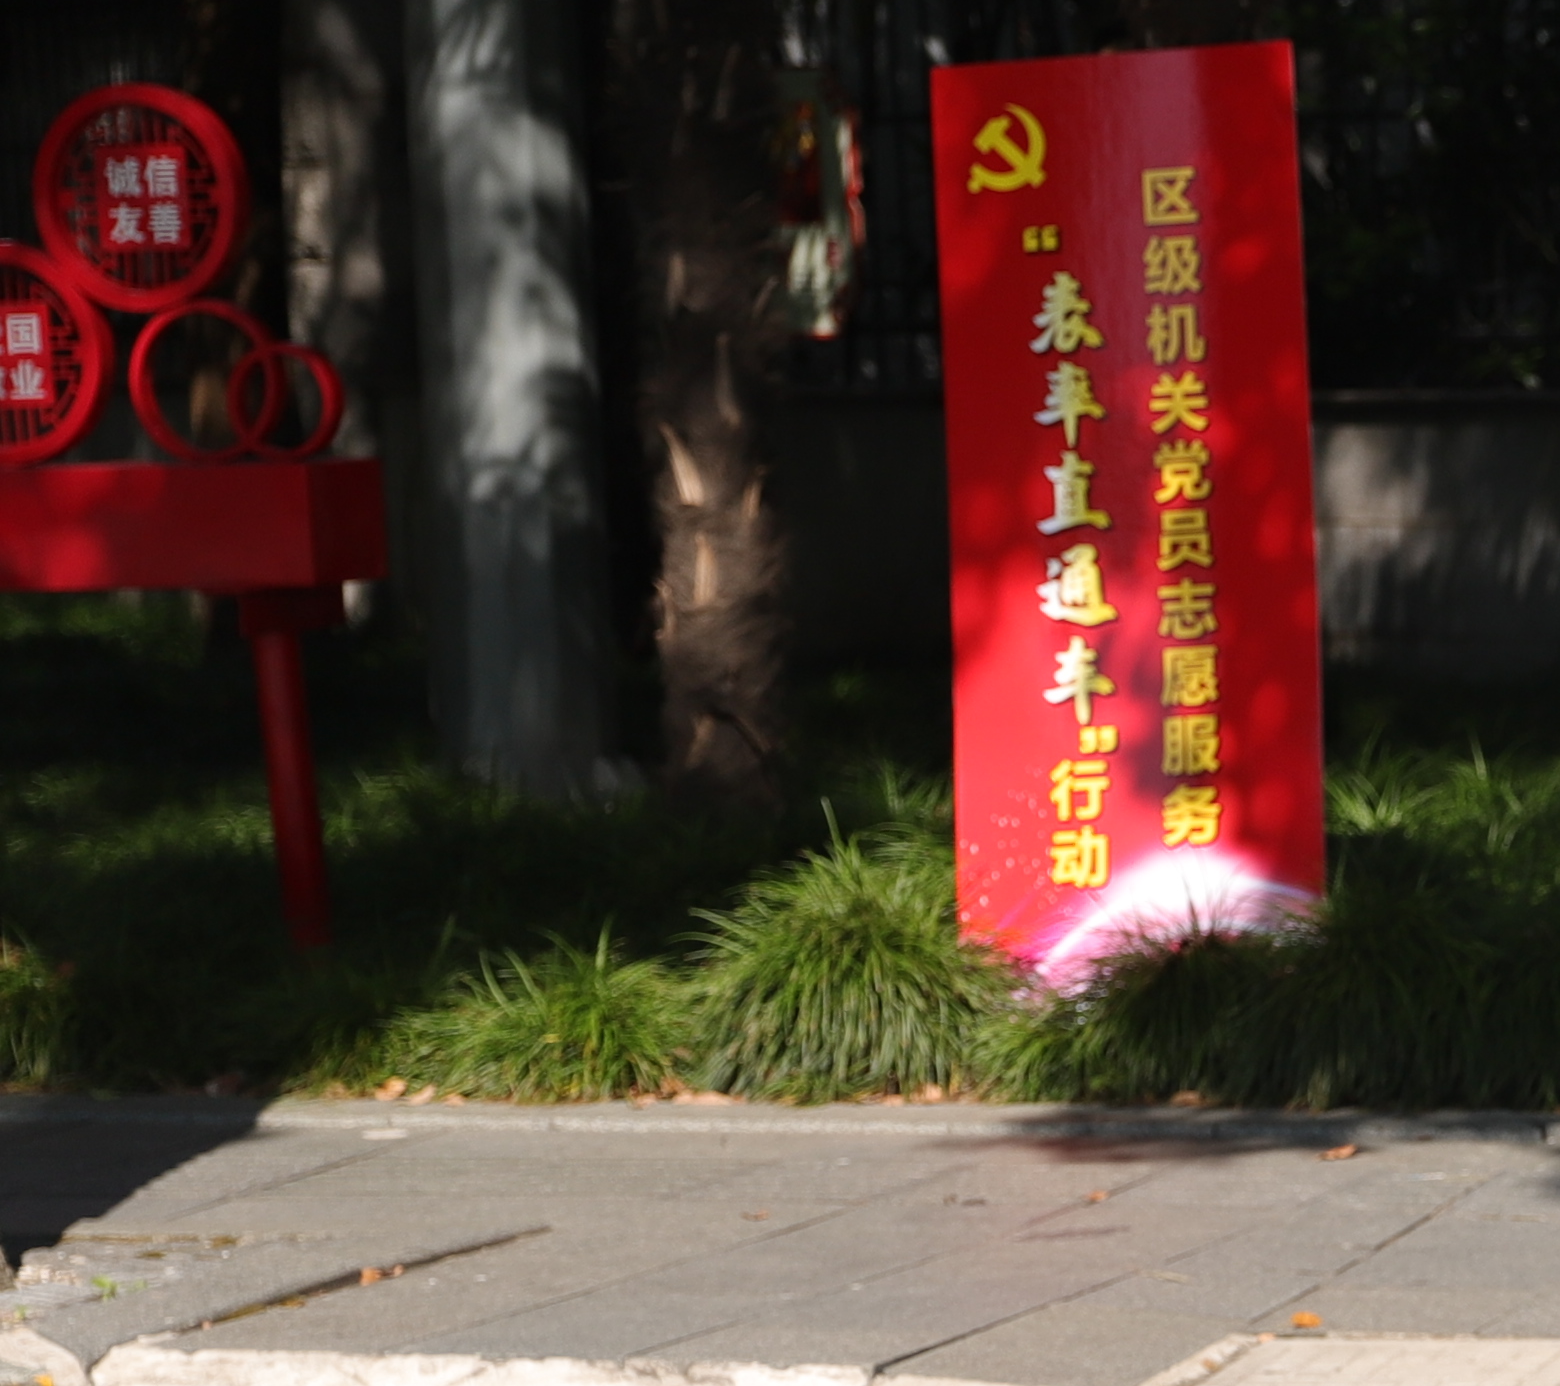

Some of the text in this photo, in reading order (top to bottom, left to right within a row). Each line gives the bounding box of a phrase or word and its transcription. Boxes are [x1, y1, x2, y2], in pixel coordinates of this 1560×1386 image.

[104, 155, 180, 198] 诚信
[108, 202, 182, 245] 友善
[0, 312, 43, 356] 国
[0, 358, 46, 401] 业
[1141, 165, 1222, 848] 区级机关党员志愿服务
